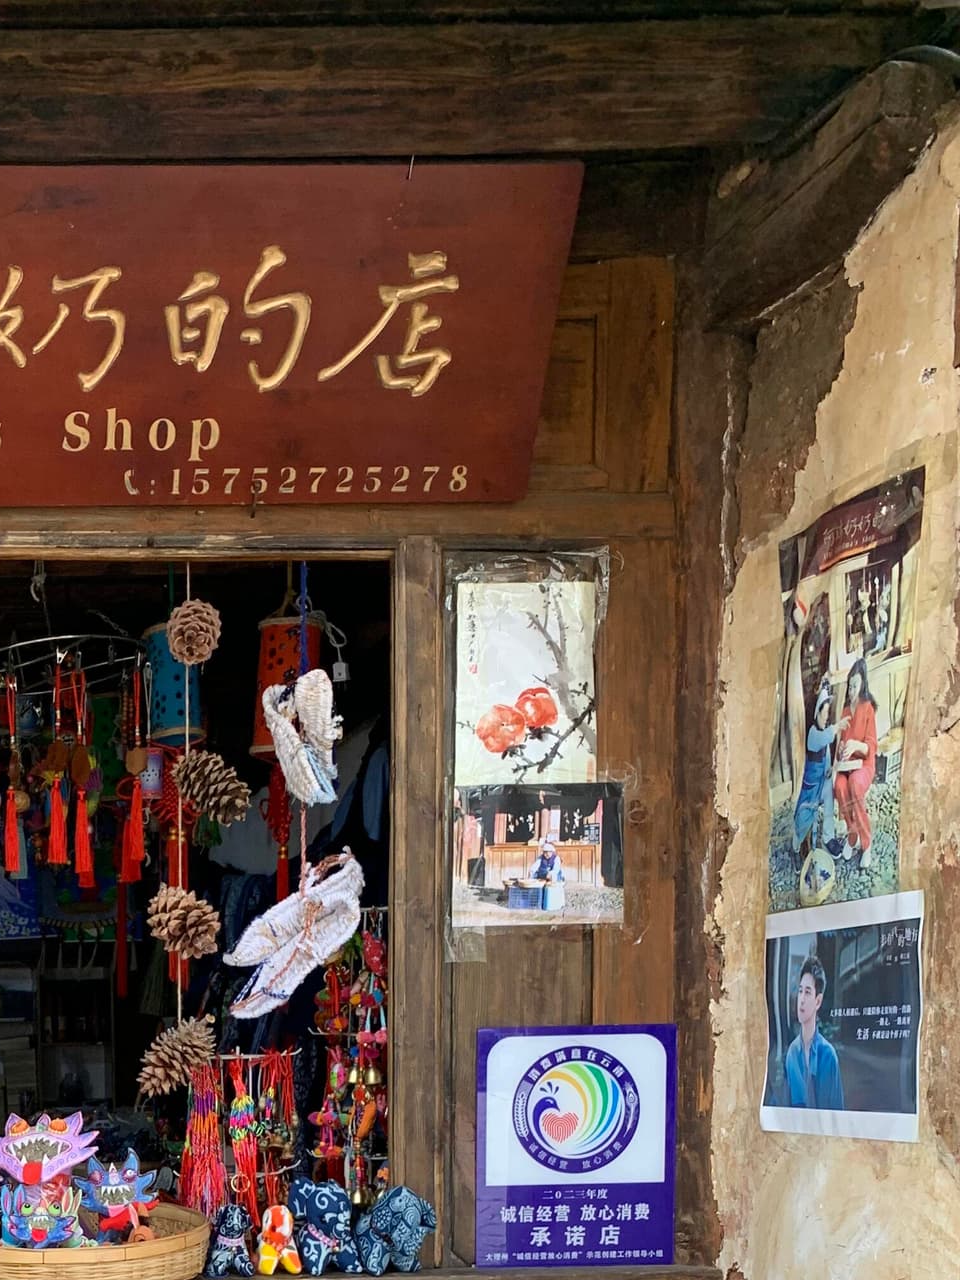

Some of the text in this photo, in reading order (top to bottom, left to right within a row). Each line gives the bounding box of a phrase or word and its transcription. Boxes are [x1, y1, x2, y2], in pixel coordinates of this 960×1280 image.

[62, 406, 221, 460] Shop
[500, 1203, 651, 1223] 诚信经营 放心消费
